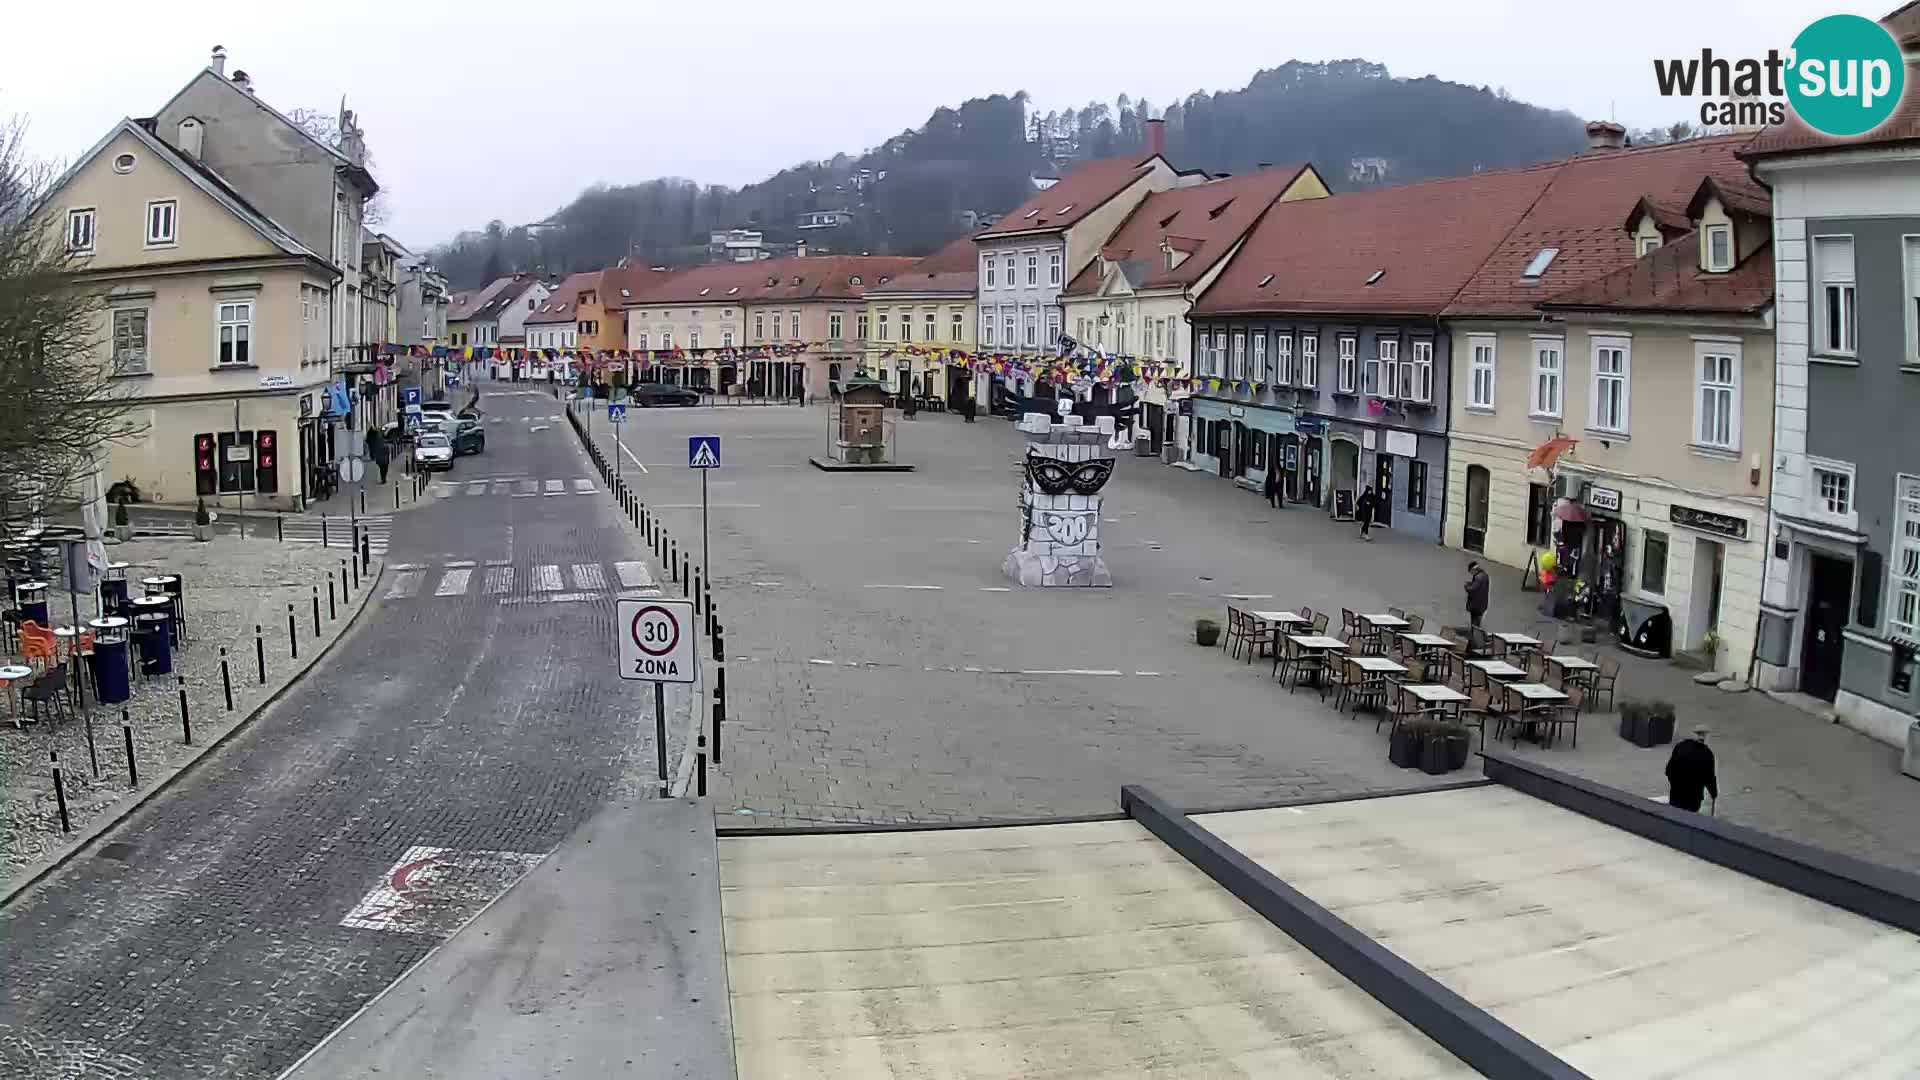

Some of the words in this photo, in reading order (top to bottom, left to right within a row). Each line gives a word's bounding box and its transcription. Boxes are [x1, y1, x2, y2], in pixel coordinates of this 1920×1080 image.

[409, 391, 417, 402] P
[1048, 515, 1087, 545] 200
[644, 621, 668, 642] 30
[634, 658, 679, 675] ZONA
